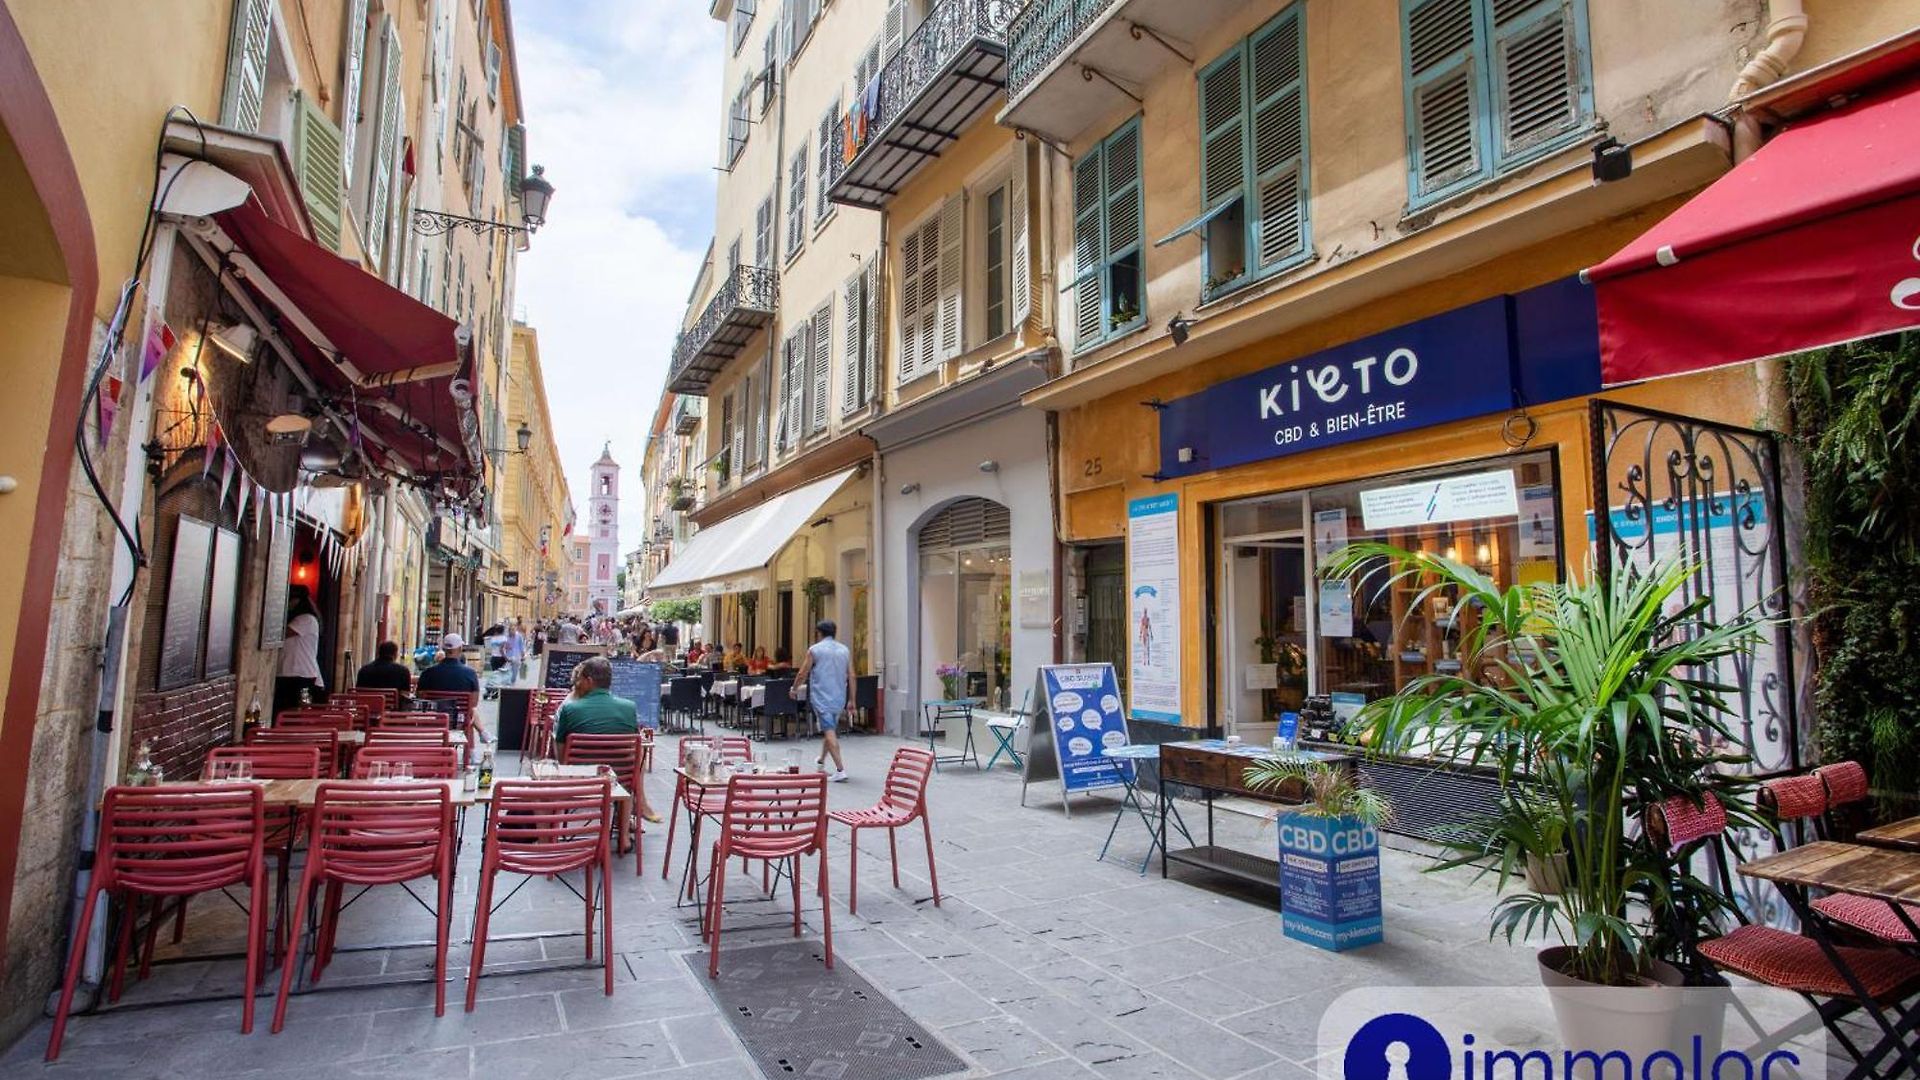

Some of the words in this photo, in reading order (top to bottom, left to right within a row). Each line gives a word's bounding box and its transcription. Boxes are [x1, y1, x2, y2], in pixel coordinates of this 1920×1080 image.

[1274, 426, 1303, 445] CBD
[1310, 422, 1320, 438] &
[1327, 402, 1406, 434] BIEN-ÊTRE
[1085, 457, 1103, 477] 25
[1281, 825, 1327, 853] CBD
[1332, 826, 1377, 854] CBD
